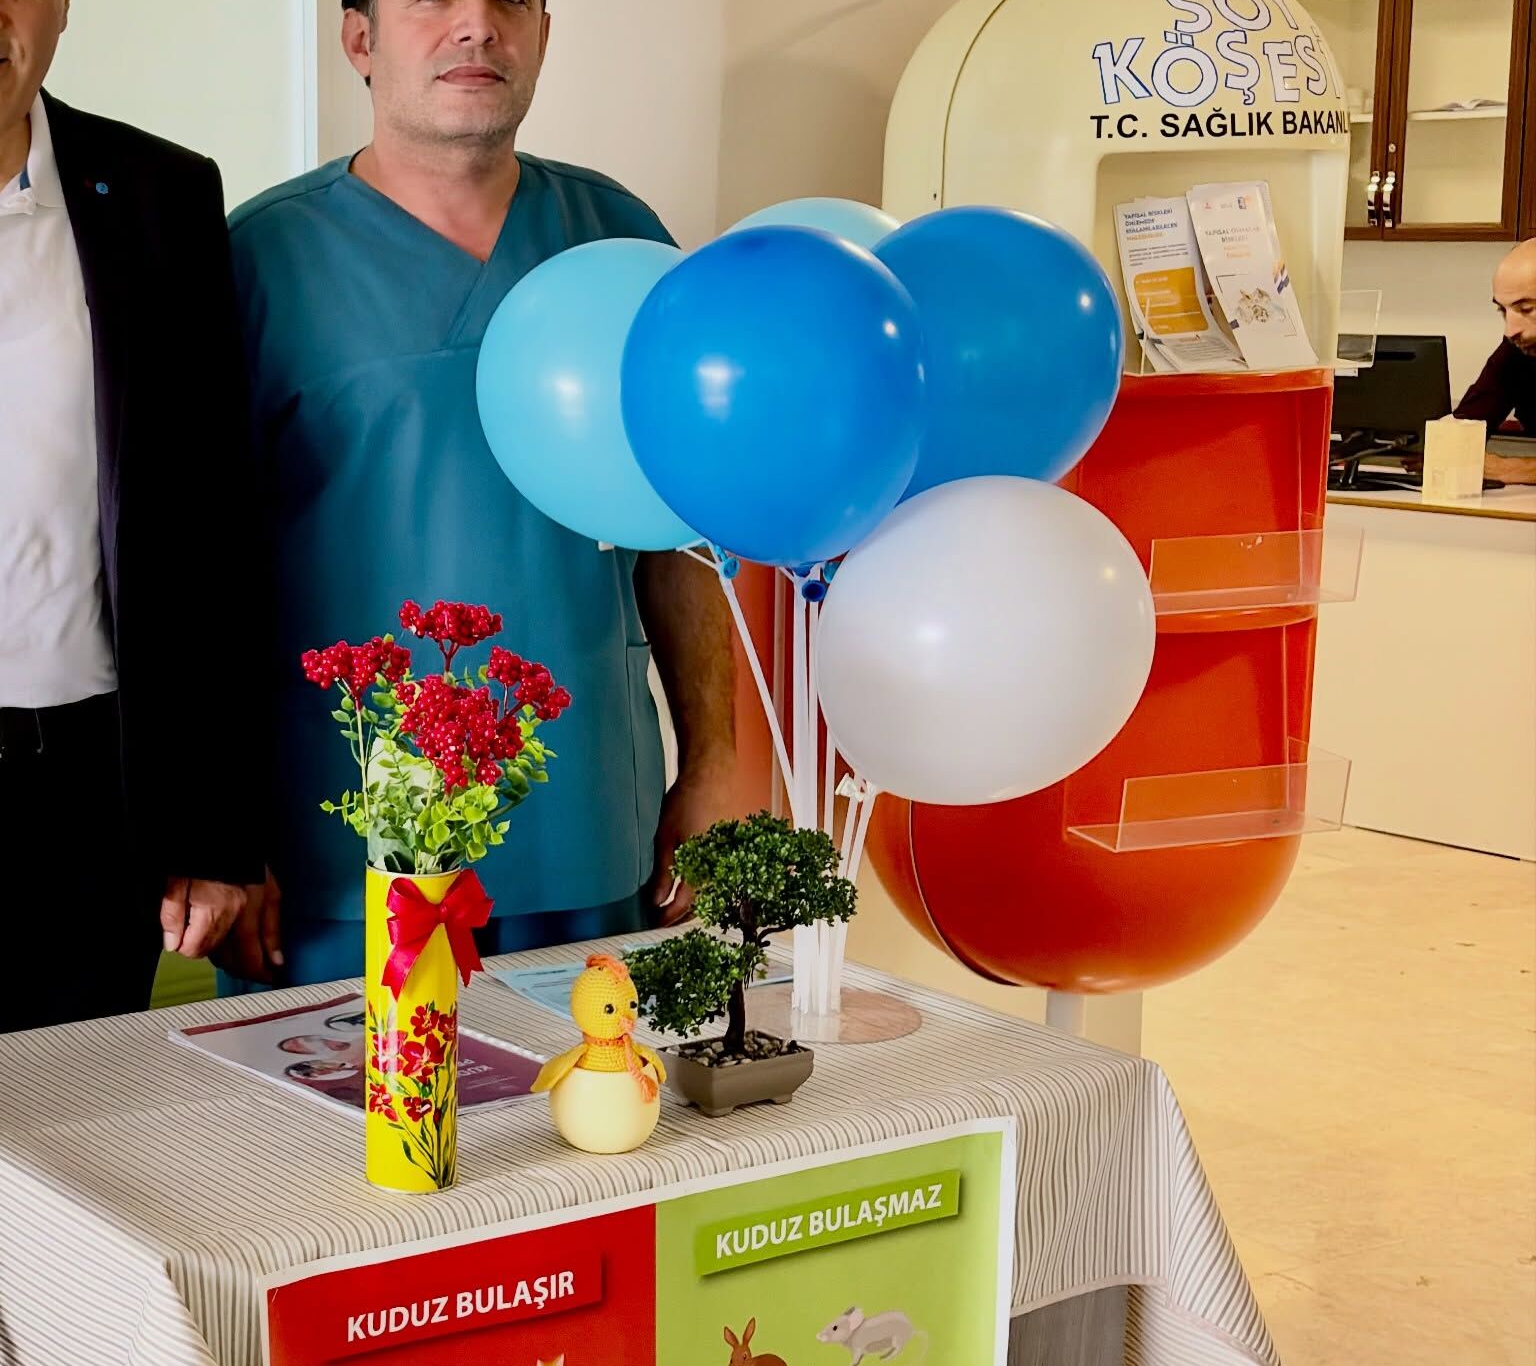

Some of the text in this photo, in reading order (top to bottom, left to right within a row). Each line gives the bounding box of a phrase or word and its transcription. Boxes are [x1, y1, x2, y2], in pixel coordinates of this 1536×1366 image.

[1090, 114, 1148, 139] T.C.
[1160, 107, 1275, 137] SAĞLIK
[716, 1184, 942, 1259] KUDUZ BULAŞMAZ
[347, 1271, 575, 1342] KUDUZ BULAŞIR
